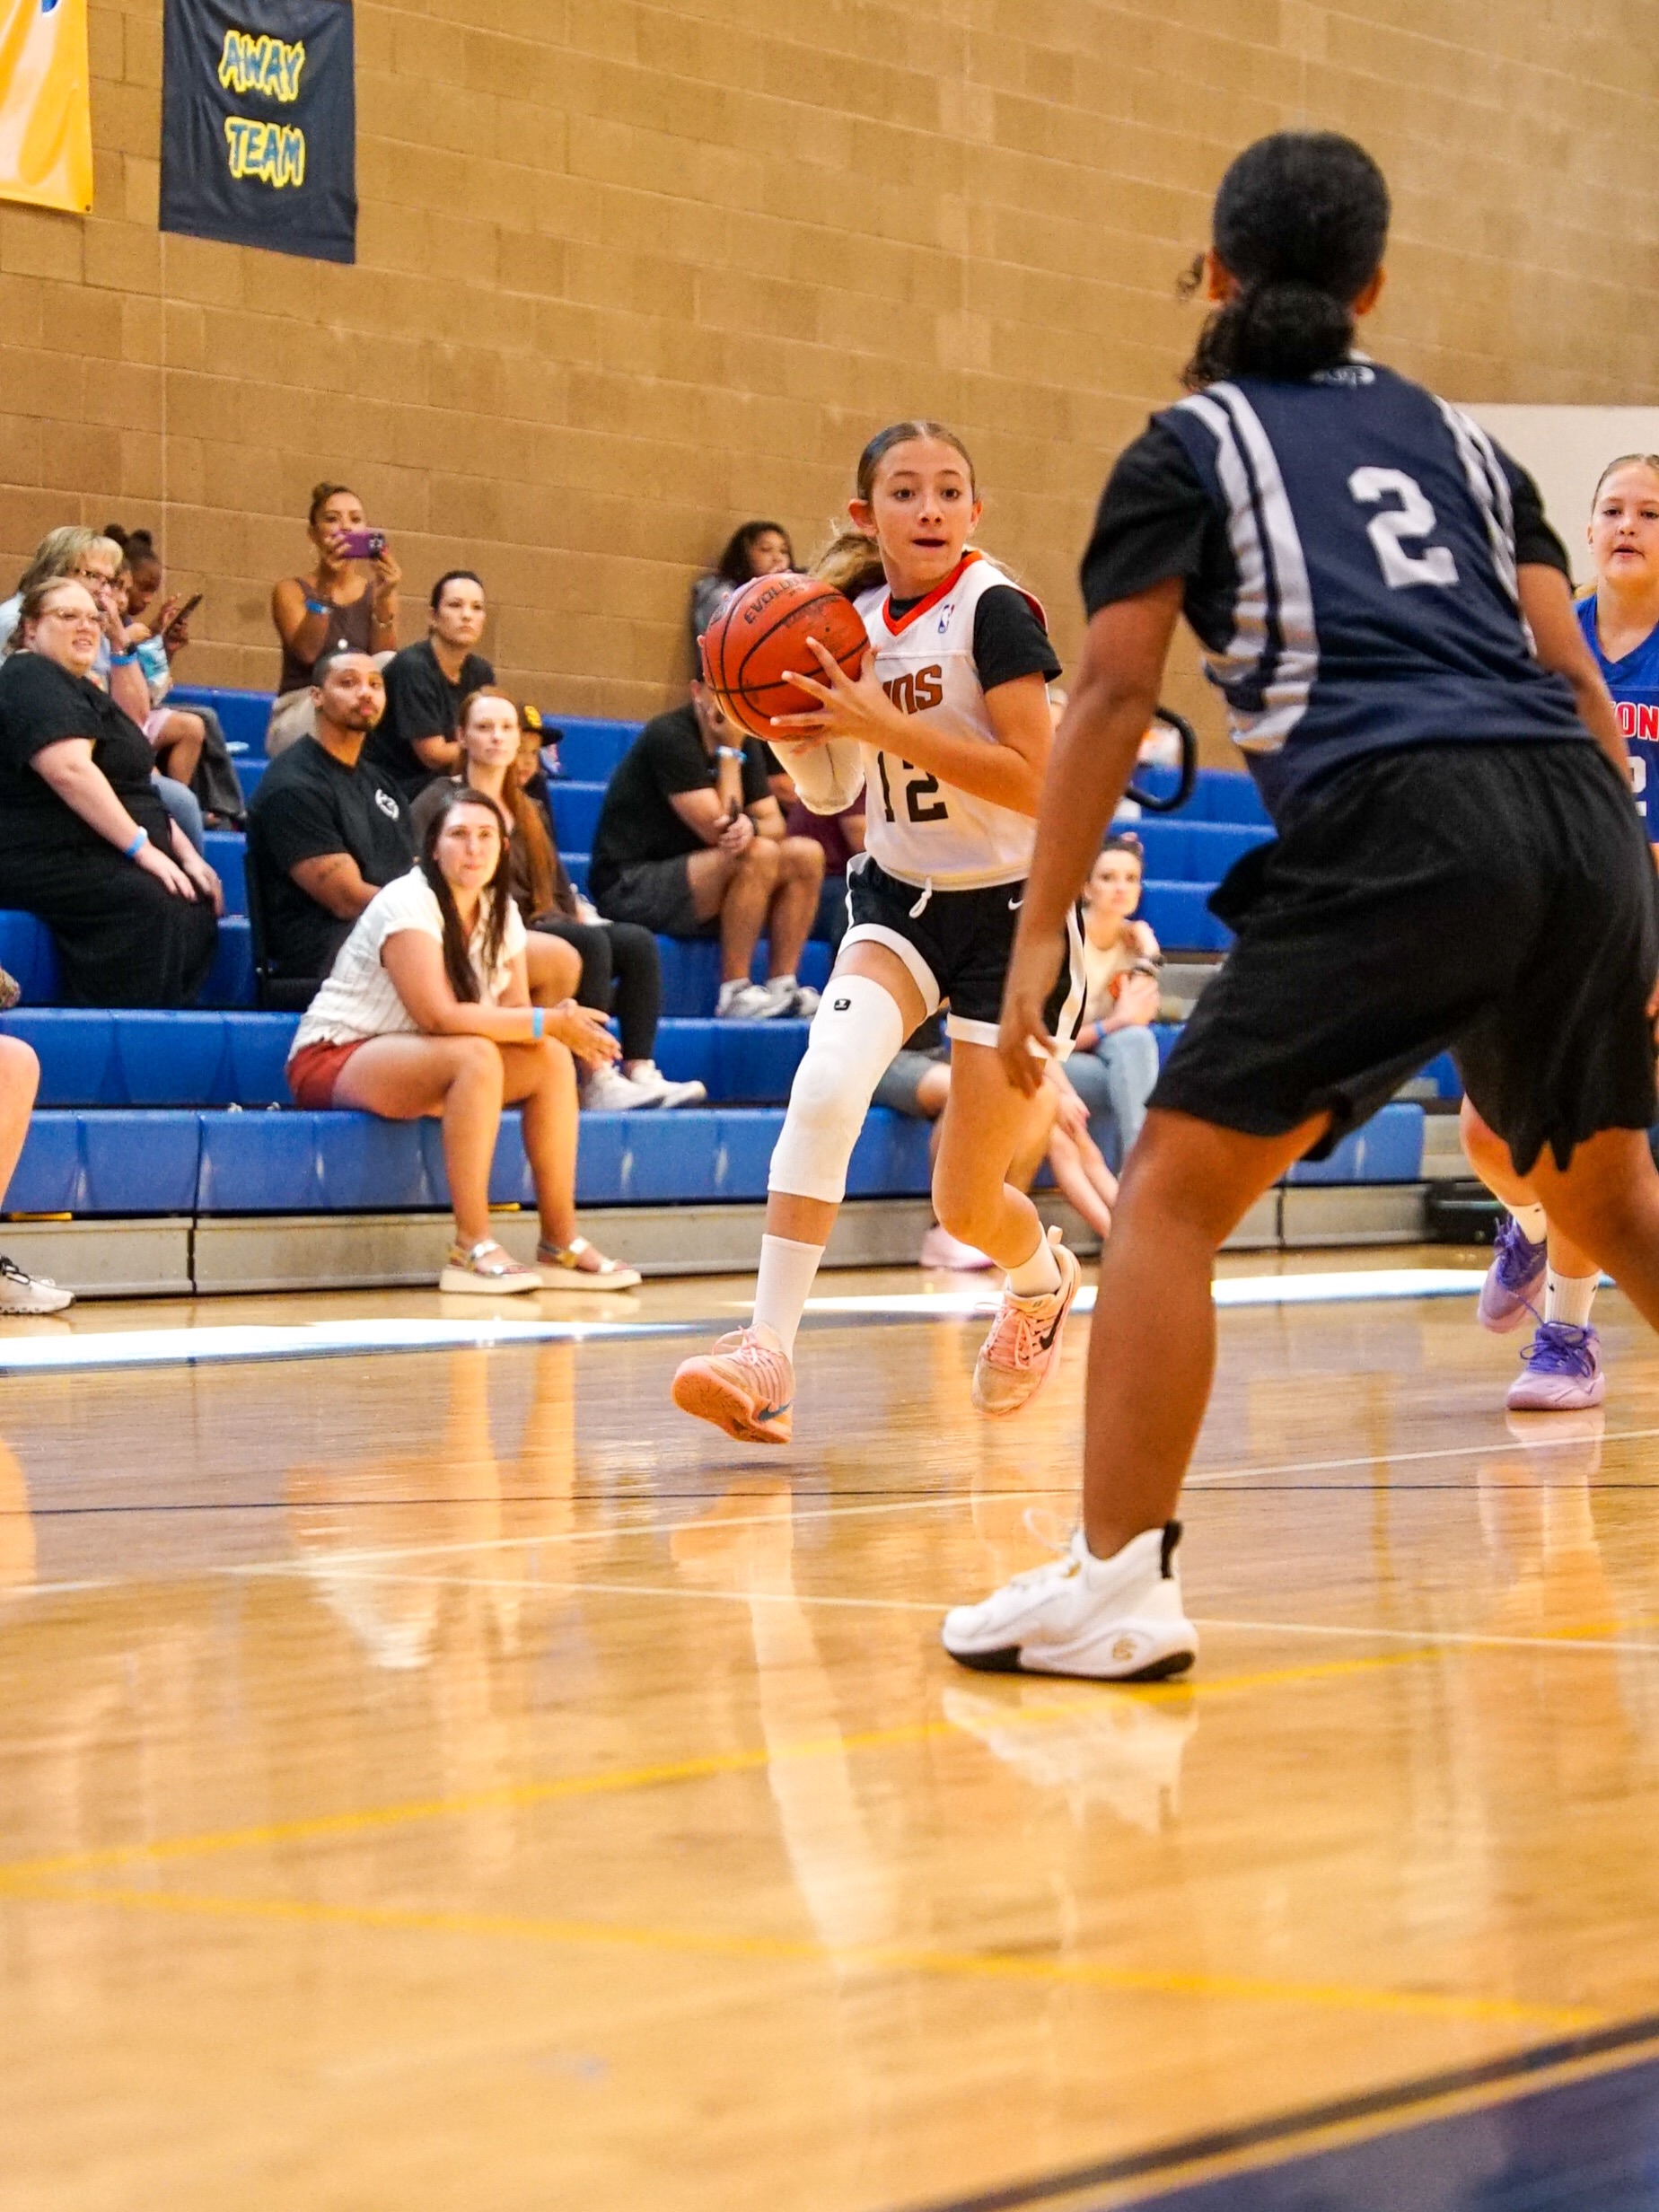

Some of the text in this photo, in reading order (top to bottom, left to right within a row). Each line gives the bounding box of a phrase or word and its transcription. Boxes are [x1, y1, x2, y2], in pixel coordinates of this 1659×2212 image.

[218, 30, 305, 102] AWAY
[224, 116, 305, 188] TEAM
[1347, 466, 1460, 590] 2
[744, 577, 796, 624] EVOLU
[1611, 701, 1659, 742] ON
[877, 750, 949, 822] 12
